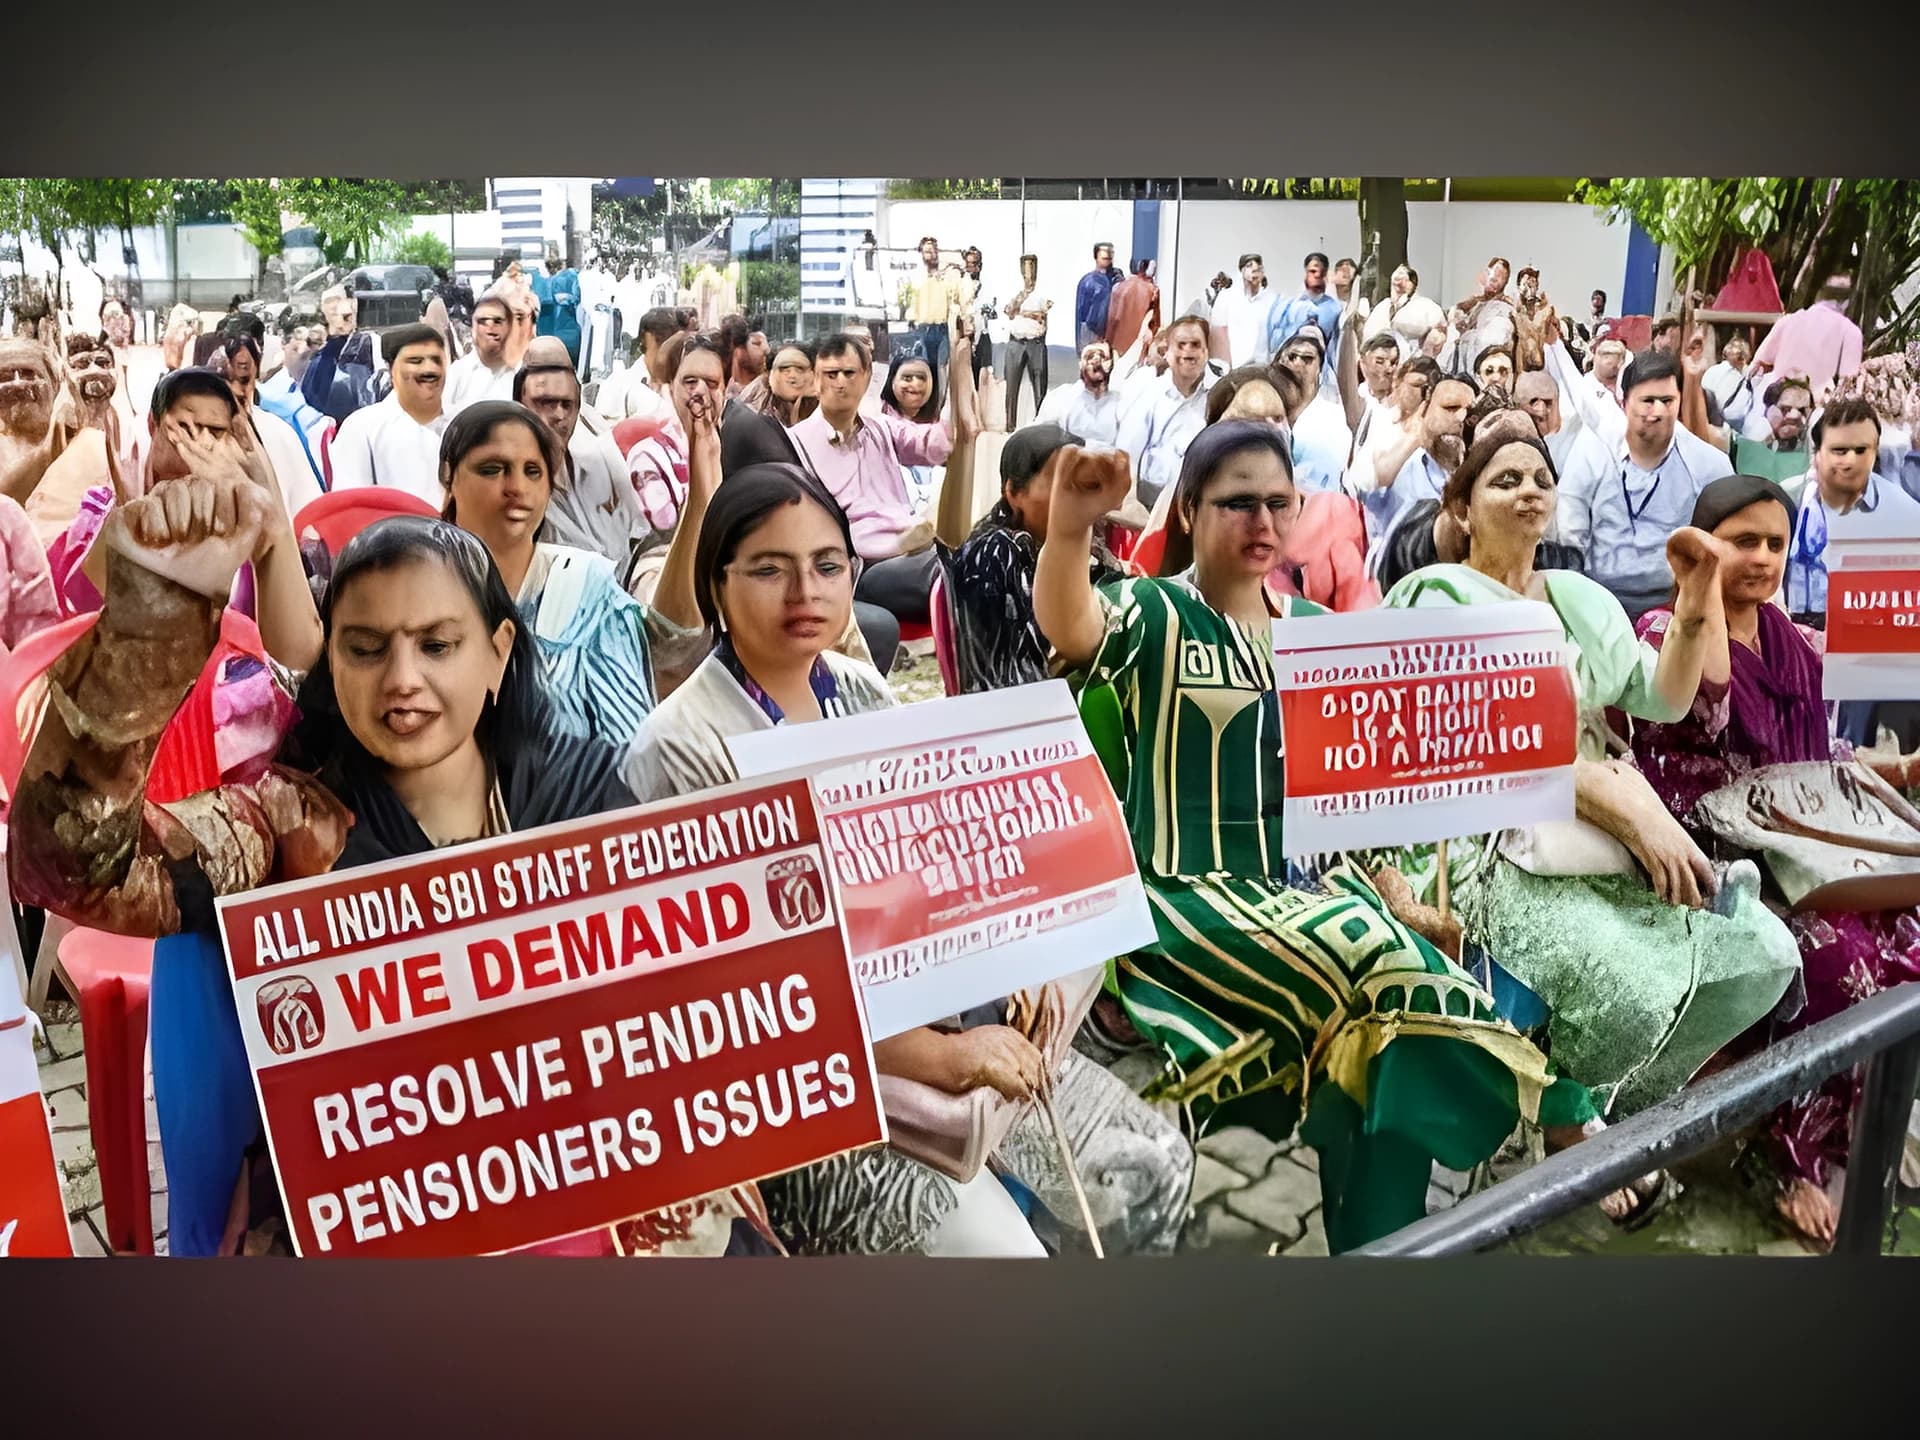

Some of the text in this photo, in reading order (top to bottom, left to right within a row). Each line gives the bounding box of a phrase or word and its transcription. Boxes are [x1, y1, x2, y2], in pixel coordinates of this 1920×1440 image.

[254, 907, 319, 967] ALL
[327, 883, 425, 946] INDIA
[430, 867, 489, 922] SBI
[493, 843, 594, 909] STAFF
[601, 795, 800, 882] FEDERATION
[335, 952, 451, 1032] WE
[468, 881, 751, 1002] DEMAND
[307, 1052, 856, 1251] PENSIONERS ISSUES
[313, 973, 817, 1159] RESOLVE PENDING
